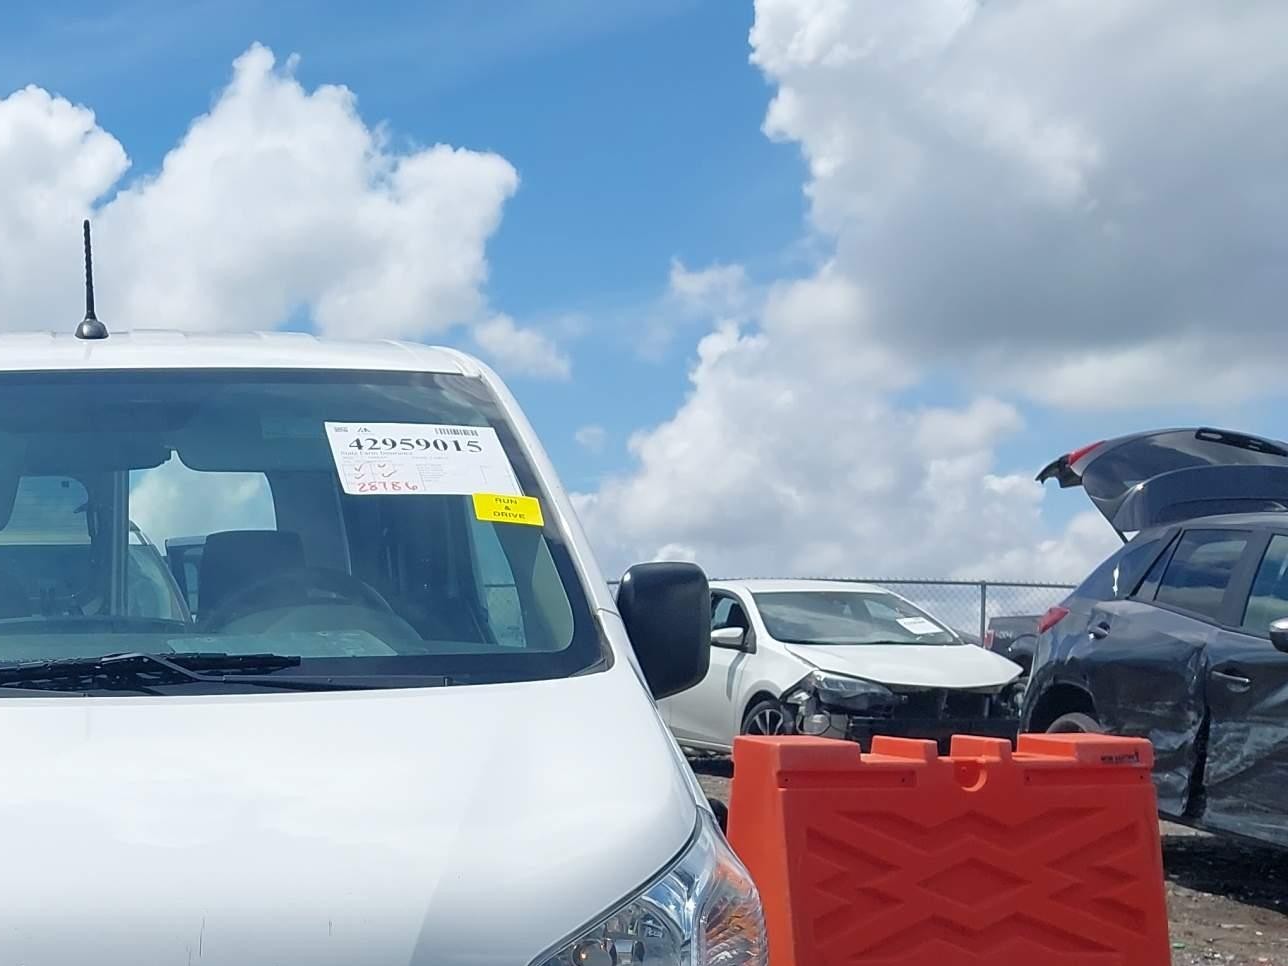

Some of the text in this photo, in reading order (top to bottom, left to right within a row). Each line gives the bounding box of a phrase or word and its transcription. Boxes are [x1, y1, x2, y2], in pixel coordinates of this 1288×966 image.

[348, 437, 483, 453] 42959015
[495, 497, 518, 505] RUN
[493, 511, 527, 519] DRIVE
